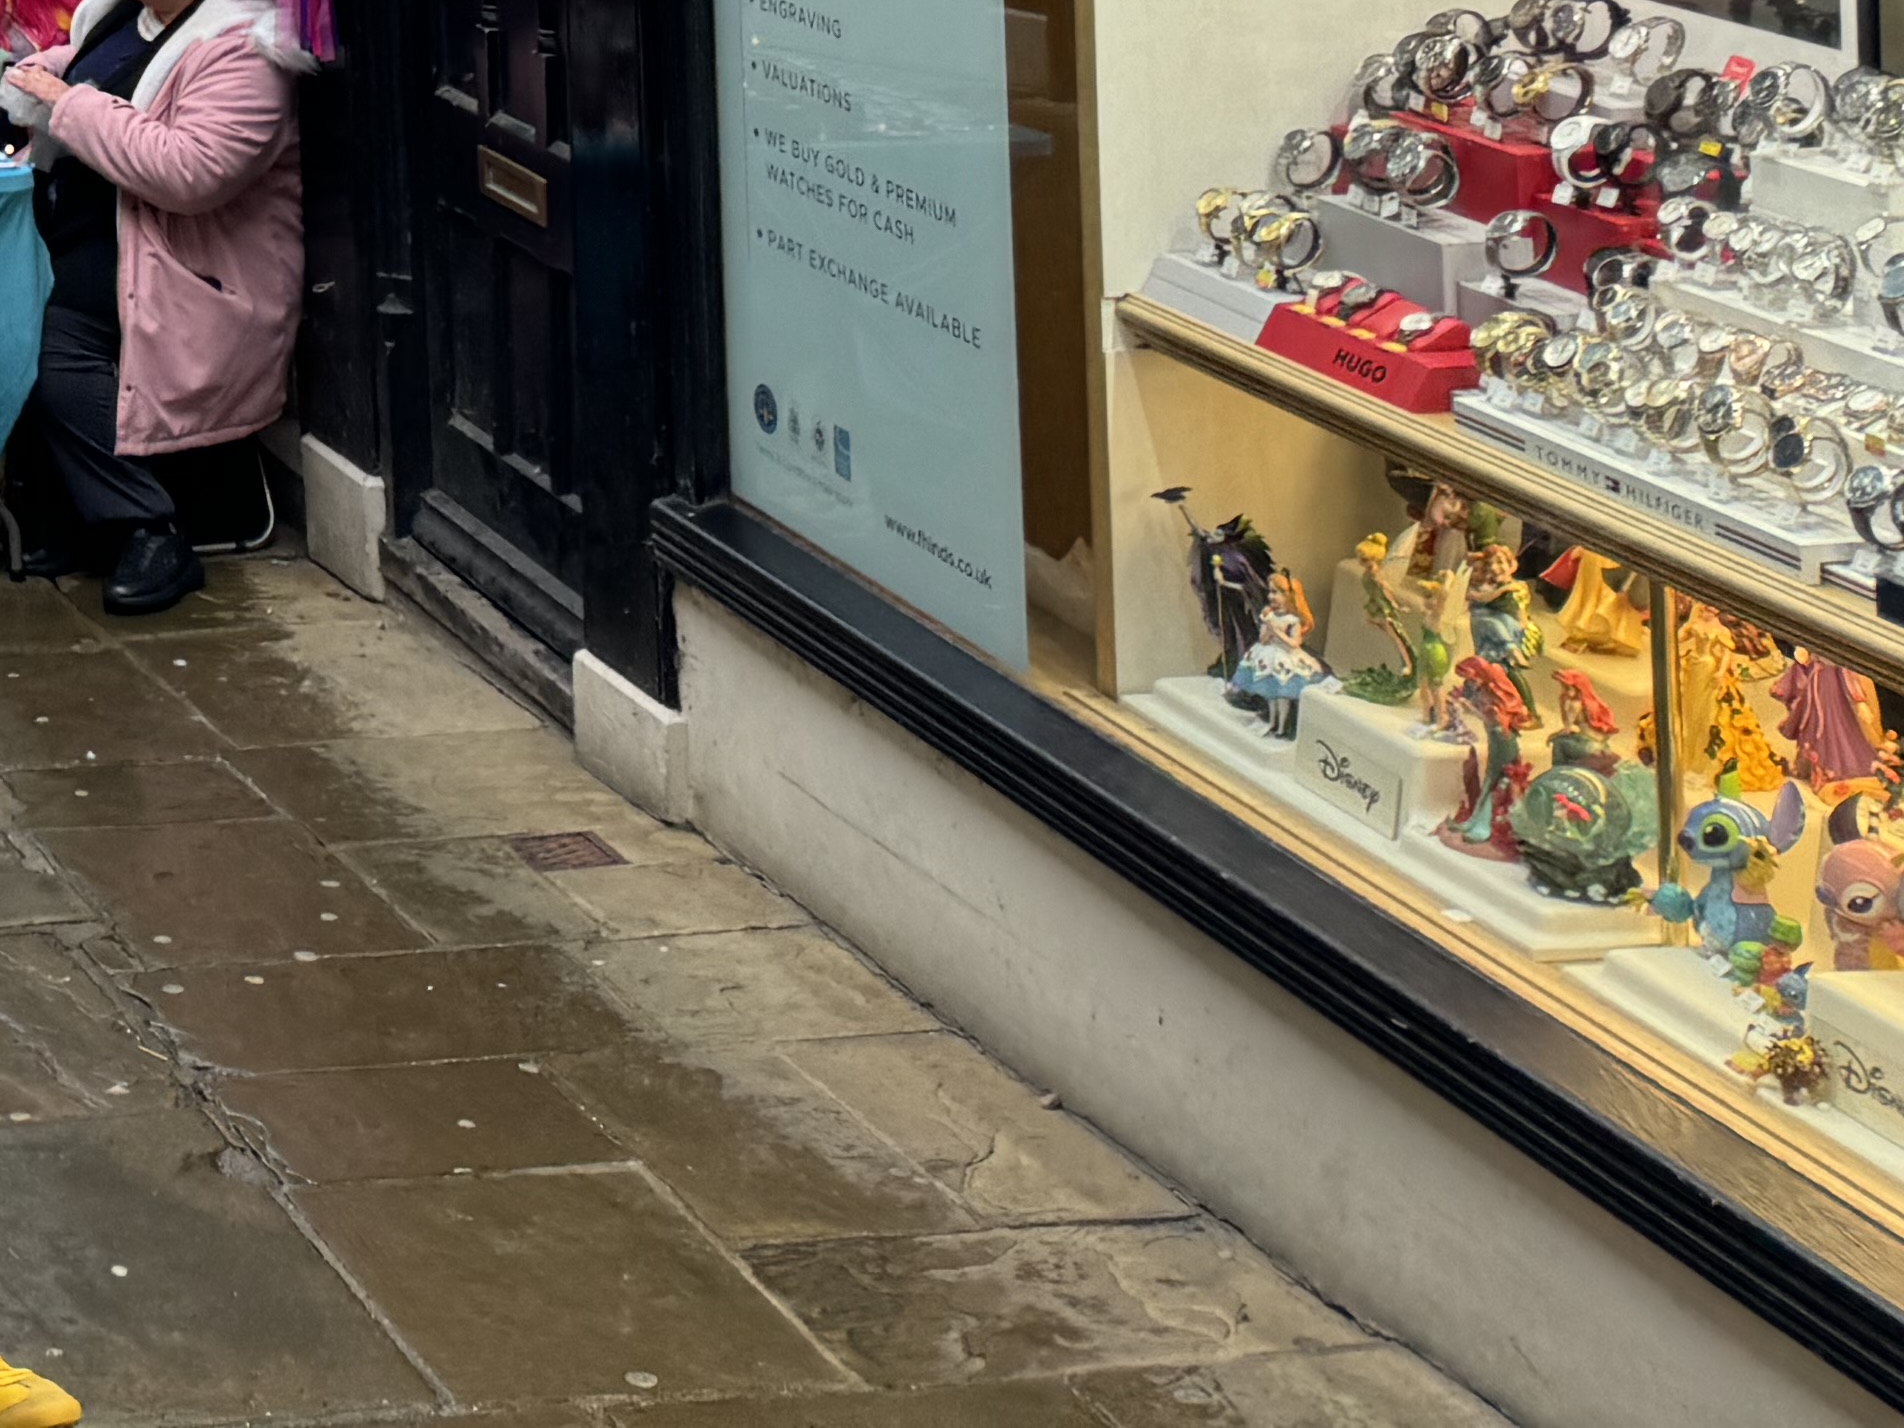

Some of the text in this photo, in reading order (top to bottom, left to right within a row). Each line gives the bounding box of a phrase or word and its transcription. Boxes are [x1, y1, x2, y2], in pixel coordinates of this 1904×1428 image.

[762, 61, 851, 111] VALUATIONS
[764, 128, 955, 225] WE BUY GOLD & PREMIUM
[767, 164, 913, 243] WATCHES FOR CASH
[767, 229, 980, 348] PART EXCHANGE AVAILABLE
[1332, 347, 1388, 385] HUGO
[1534, 443, 1705, 530] TOMMY HILFIGER
[1315, 739, 1380, 815] Disney
